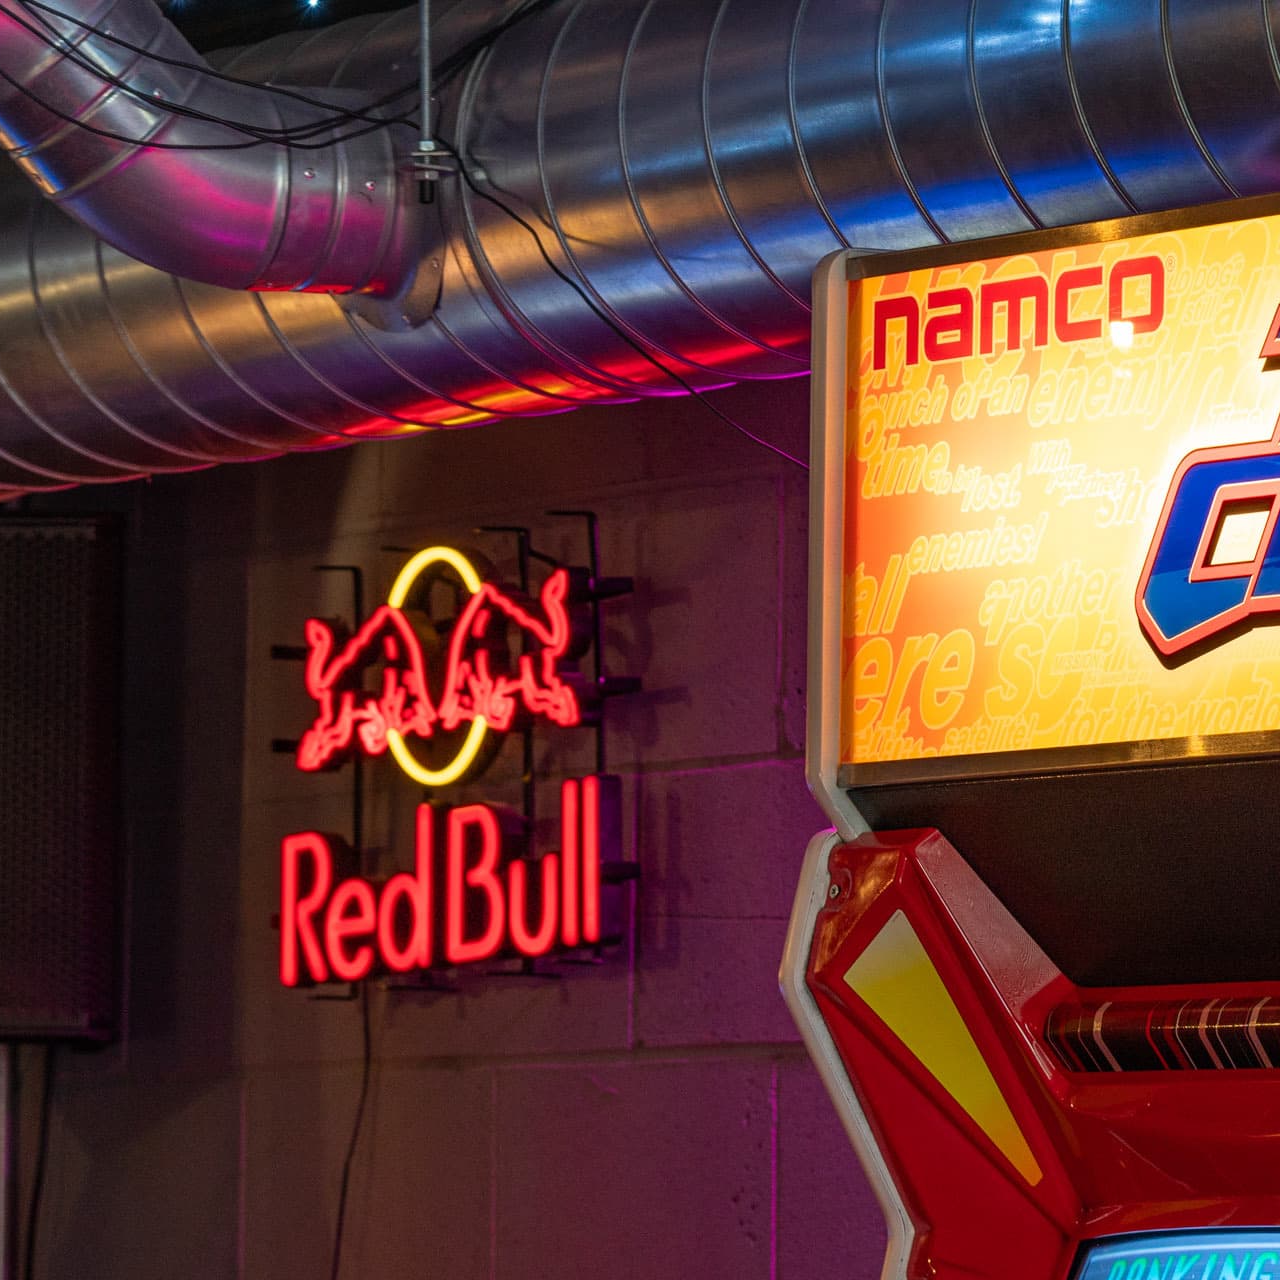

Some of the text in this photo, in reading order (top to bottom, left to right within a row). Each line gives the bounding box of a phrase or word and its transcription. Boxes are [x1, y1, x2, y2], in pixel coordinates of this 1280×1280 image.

[873, 255, 1166, 371] namco
[279, 775, 602, 988] Red Bull
